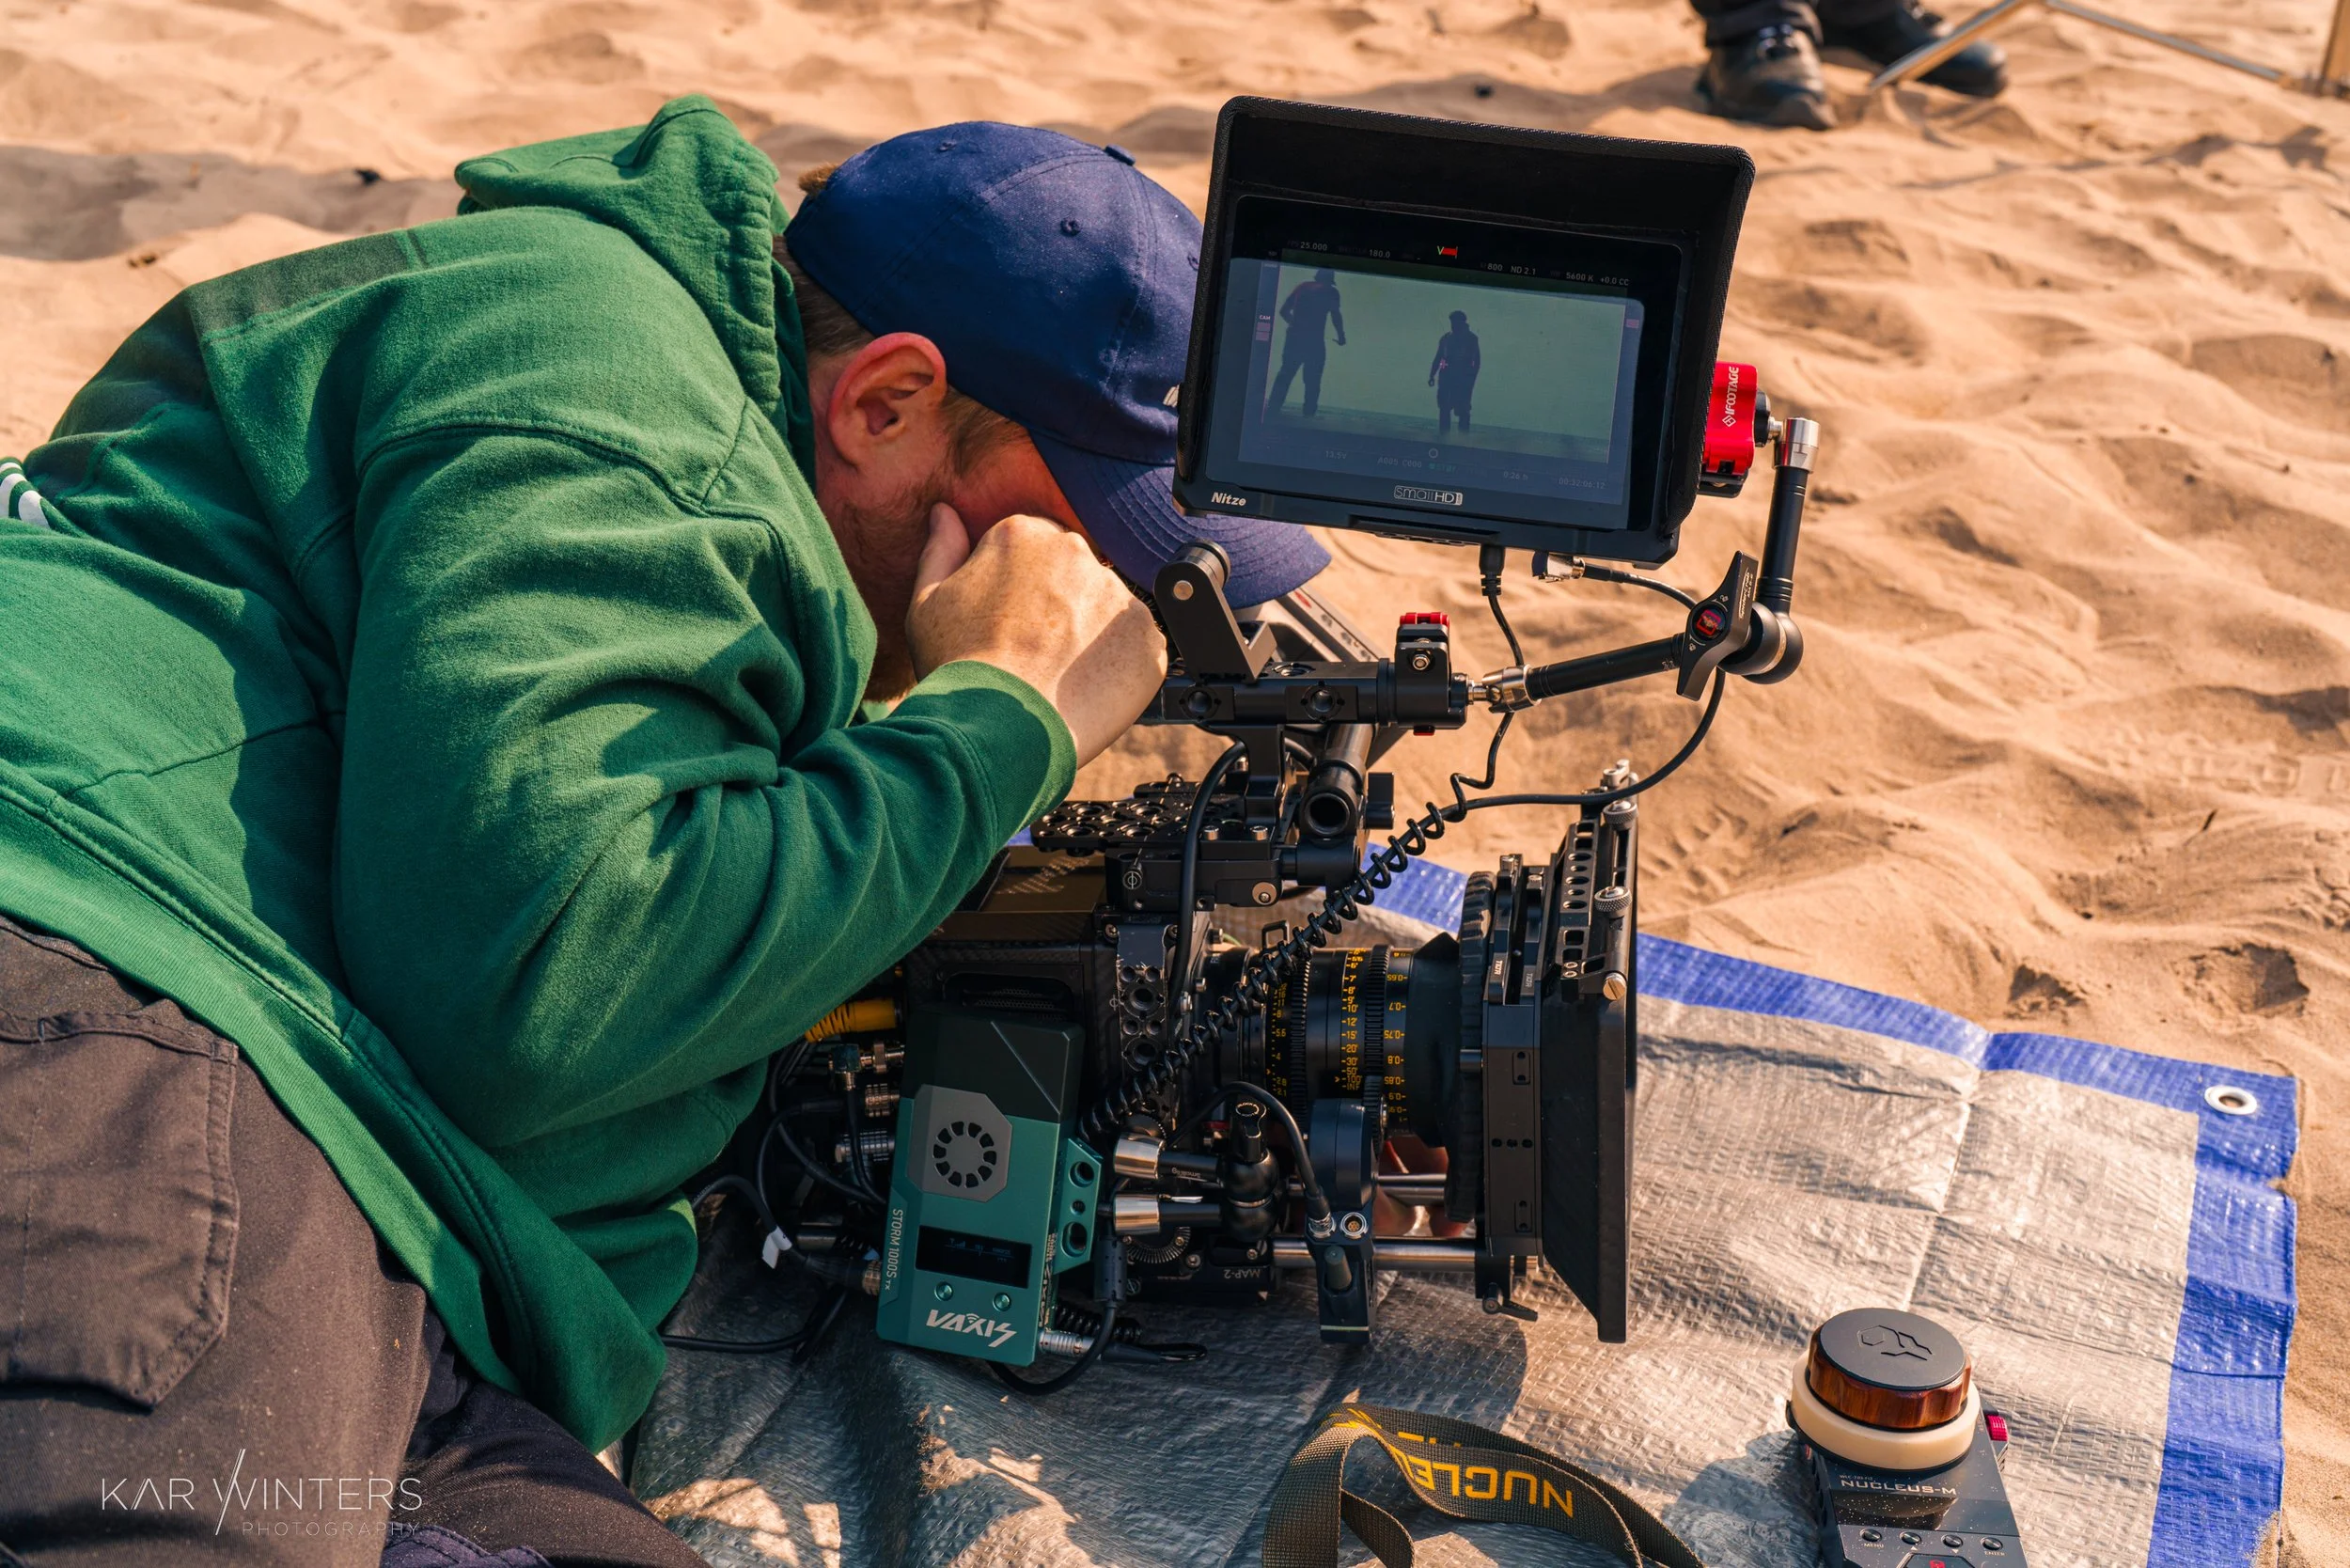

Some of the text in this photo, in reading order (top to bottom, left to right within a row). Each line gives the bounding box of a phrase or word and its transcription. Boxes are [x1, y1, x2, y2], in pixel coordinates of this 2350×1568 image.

[1300, 241, 1327, 251] 25.000
[1369, 249, 1390, 259] 180.0
[1487, 263, 1503, 272] 800
[1566, 272, 1586, 281] 5600
[1211, 493, 1246, 507] Nitze
[885, 1208, 903, 1291] STORM 1000S TX
[1223, 1269, 1261, 1279] MAP-2
[925, 1309, 1017, 1348] VAXIS
[1841, 1480, 1957, 1496] NUCLEUS-M
